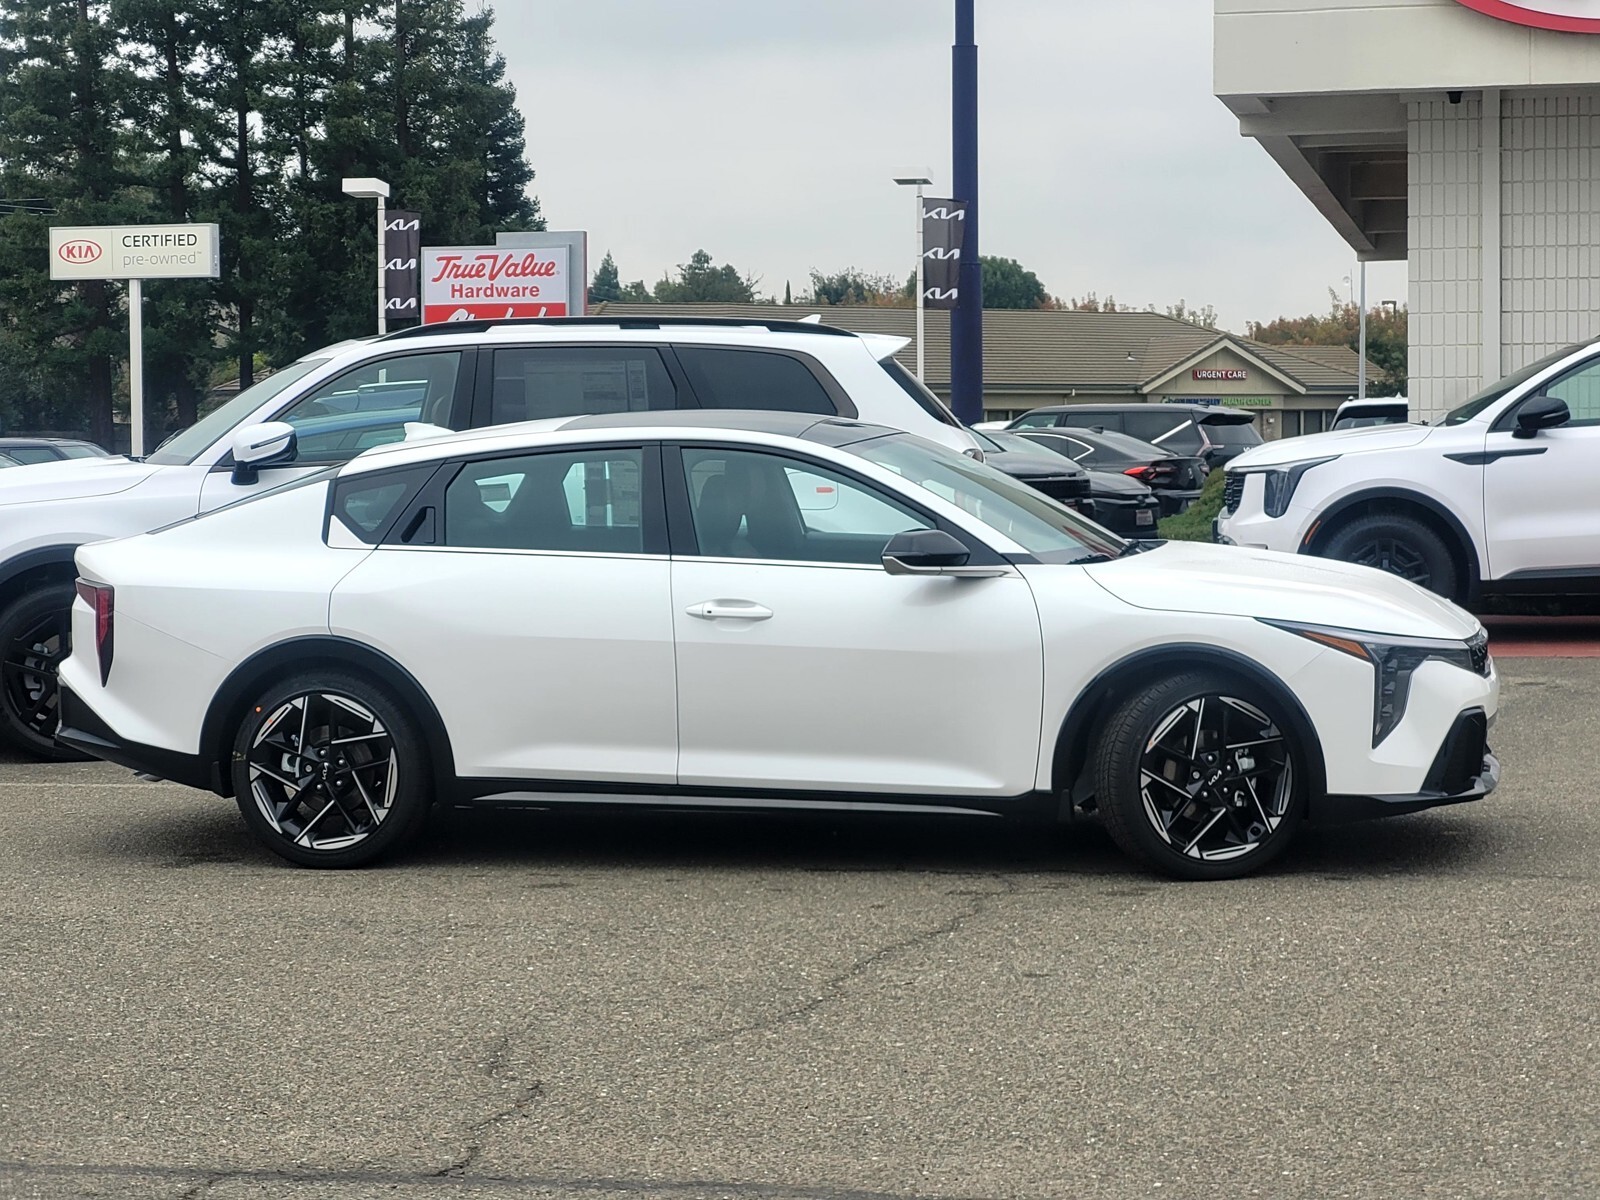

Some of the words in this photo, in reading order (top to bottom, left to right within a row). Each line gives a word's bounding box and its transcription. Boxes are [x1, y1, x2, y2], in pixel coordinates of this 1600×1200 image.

[122, 233, 198, 248] CERTIFIED
[66, 245, 96, 259] KIA
[451, 283, 540, 299] Hardware
[1197, 370, 1227, 379] URGENT
[1228, 370, 1247, 379] CARE
